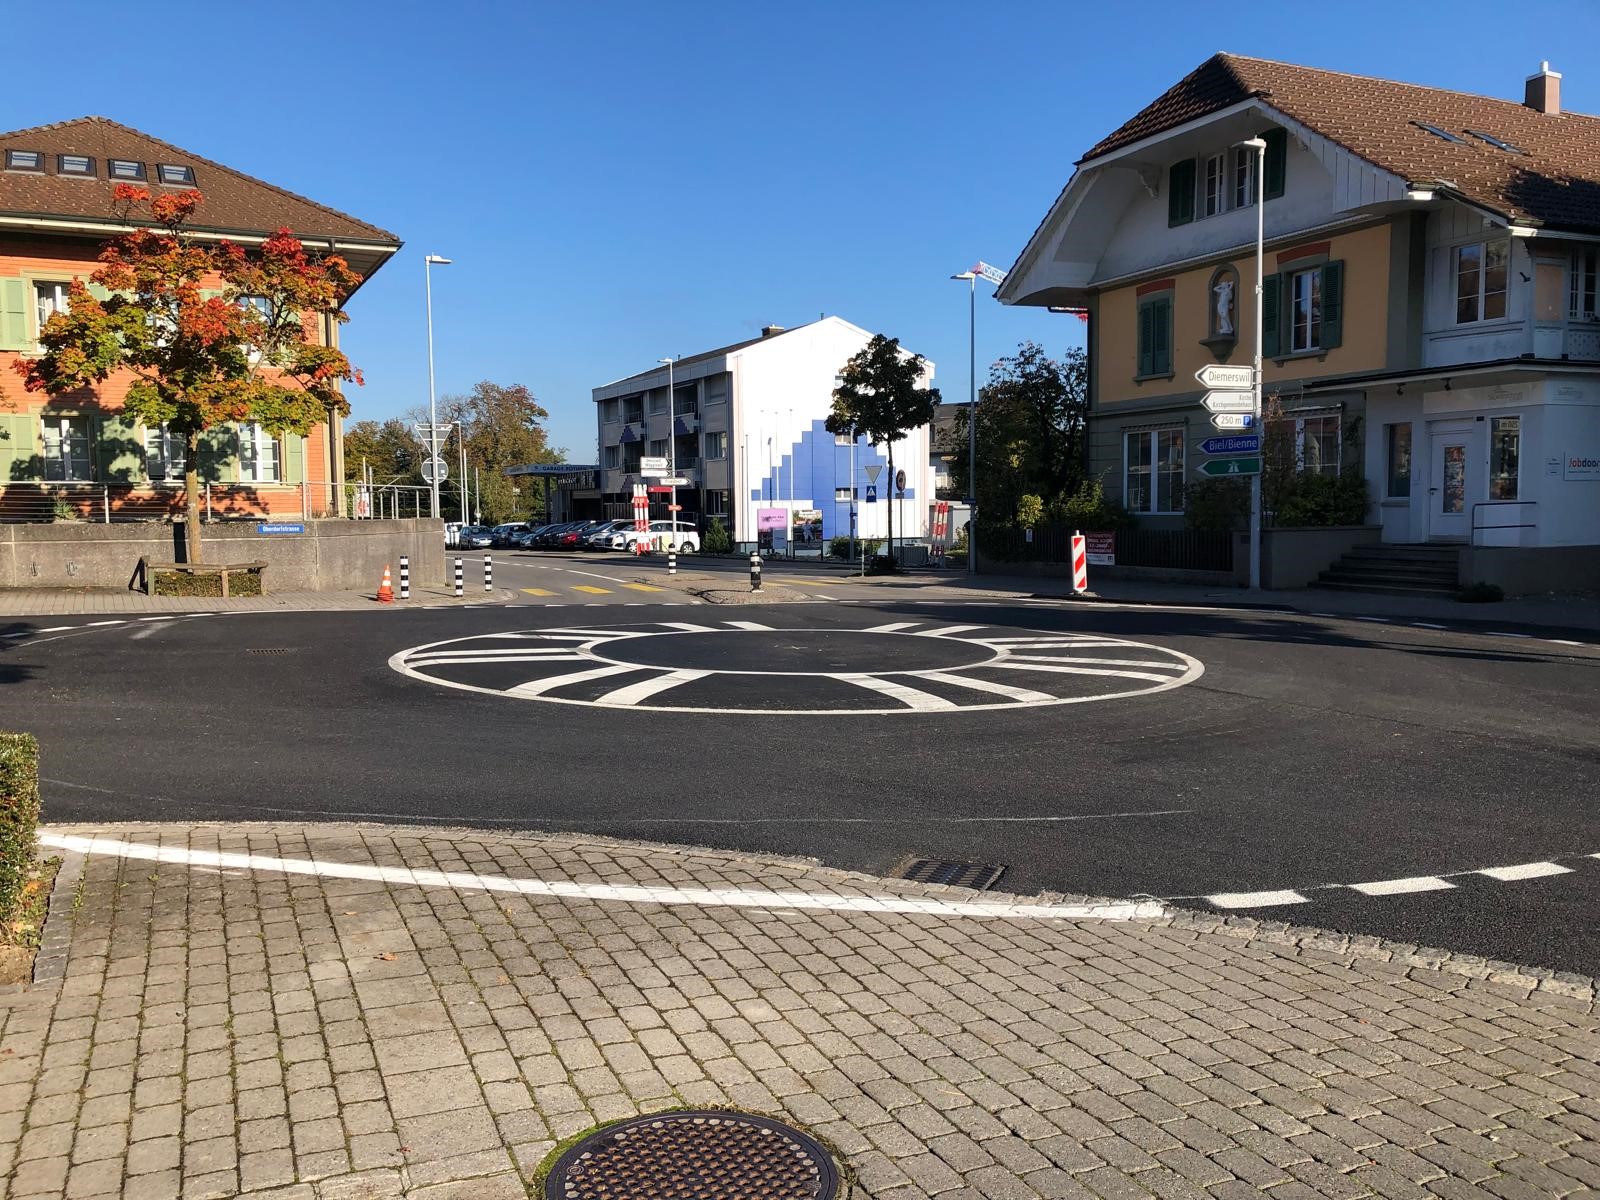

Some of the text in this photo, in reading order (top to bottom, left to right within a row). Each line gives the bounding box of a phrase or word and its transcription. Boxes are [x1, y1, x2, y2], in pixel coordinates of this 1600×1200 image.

[1208, 370, 1250, 382] Diemerswil
[1220, 415, 1234, 425] 250
[1209, 438, 1258, 451] Biel/Bienne
